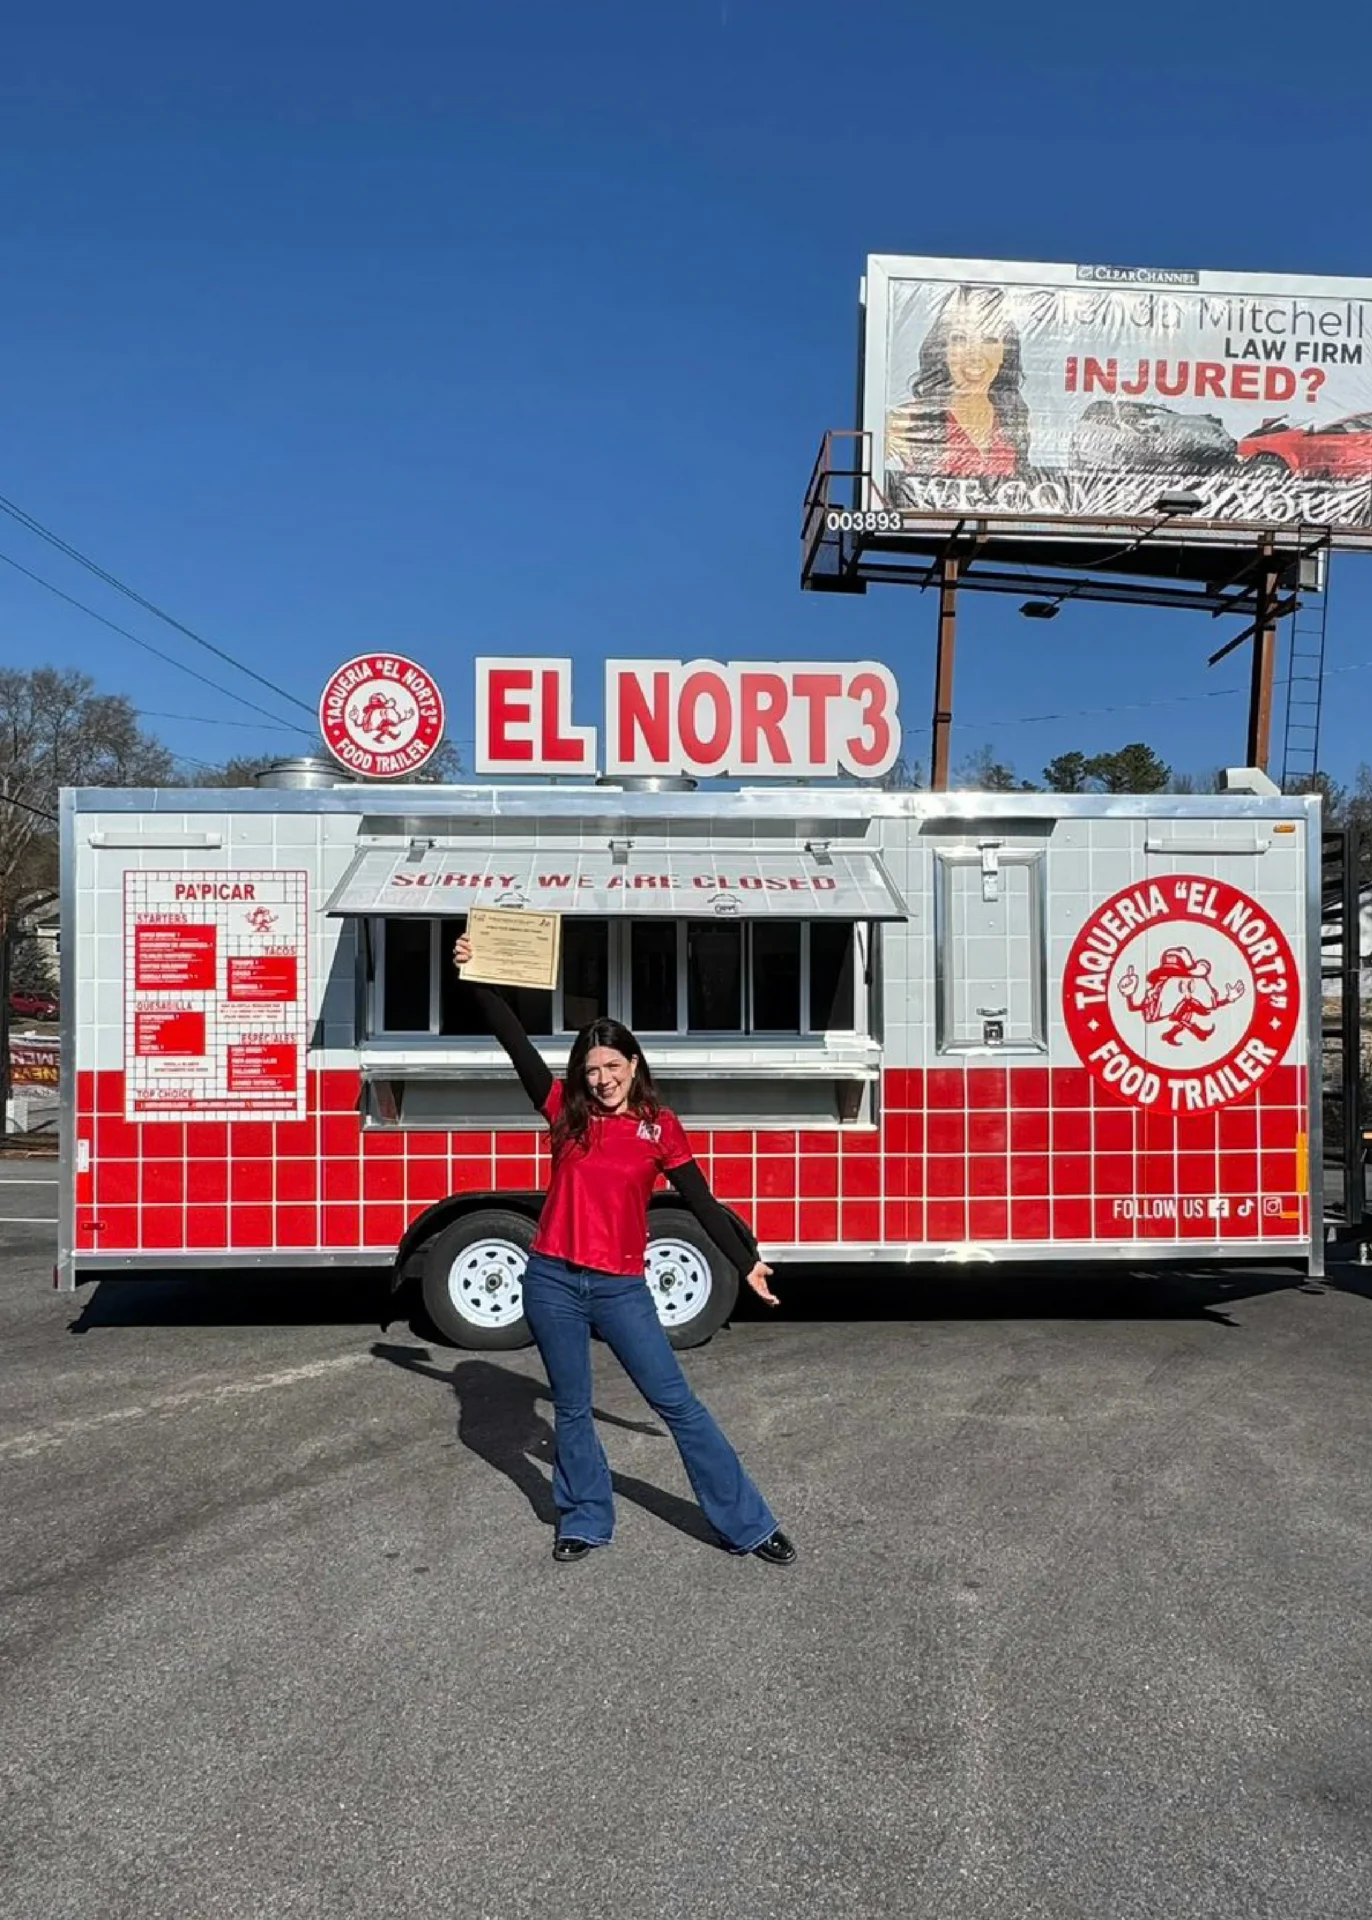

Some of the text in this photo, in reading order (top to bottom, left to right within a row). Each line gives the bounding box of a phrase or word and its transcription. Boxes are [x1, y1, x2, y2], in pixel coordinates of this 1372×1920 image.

[1199, 297, 1364, 339] Mitchell
[1224, 337, 1363, 365] LAW FIRM
[1064, 356, 1327, 404] INJURED?
[826, 512, 901, 531] 003893
[326, 661, 374, 726] TAQUERIA
[488, 669, 892, 767] EL NORT3
[335, 737, 430, 773] FOOD TRAILER
[174, 883, 256, 901] PA'PICAR
[390, 873, 838, 891] SORRY, WE ARE CLOSED
[136, 912, 188, 924] STARTERS
[264, 945, 297, 955] TACOS
[1074, 884, 1170, 1011] TAQUERIA
[1089, 1037, 1279, 1111] FOOD TRAILER
[1113, 1199, 1204, 1219] FOLLOW US
